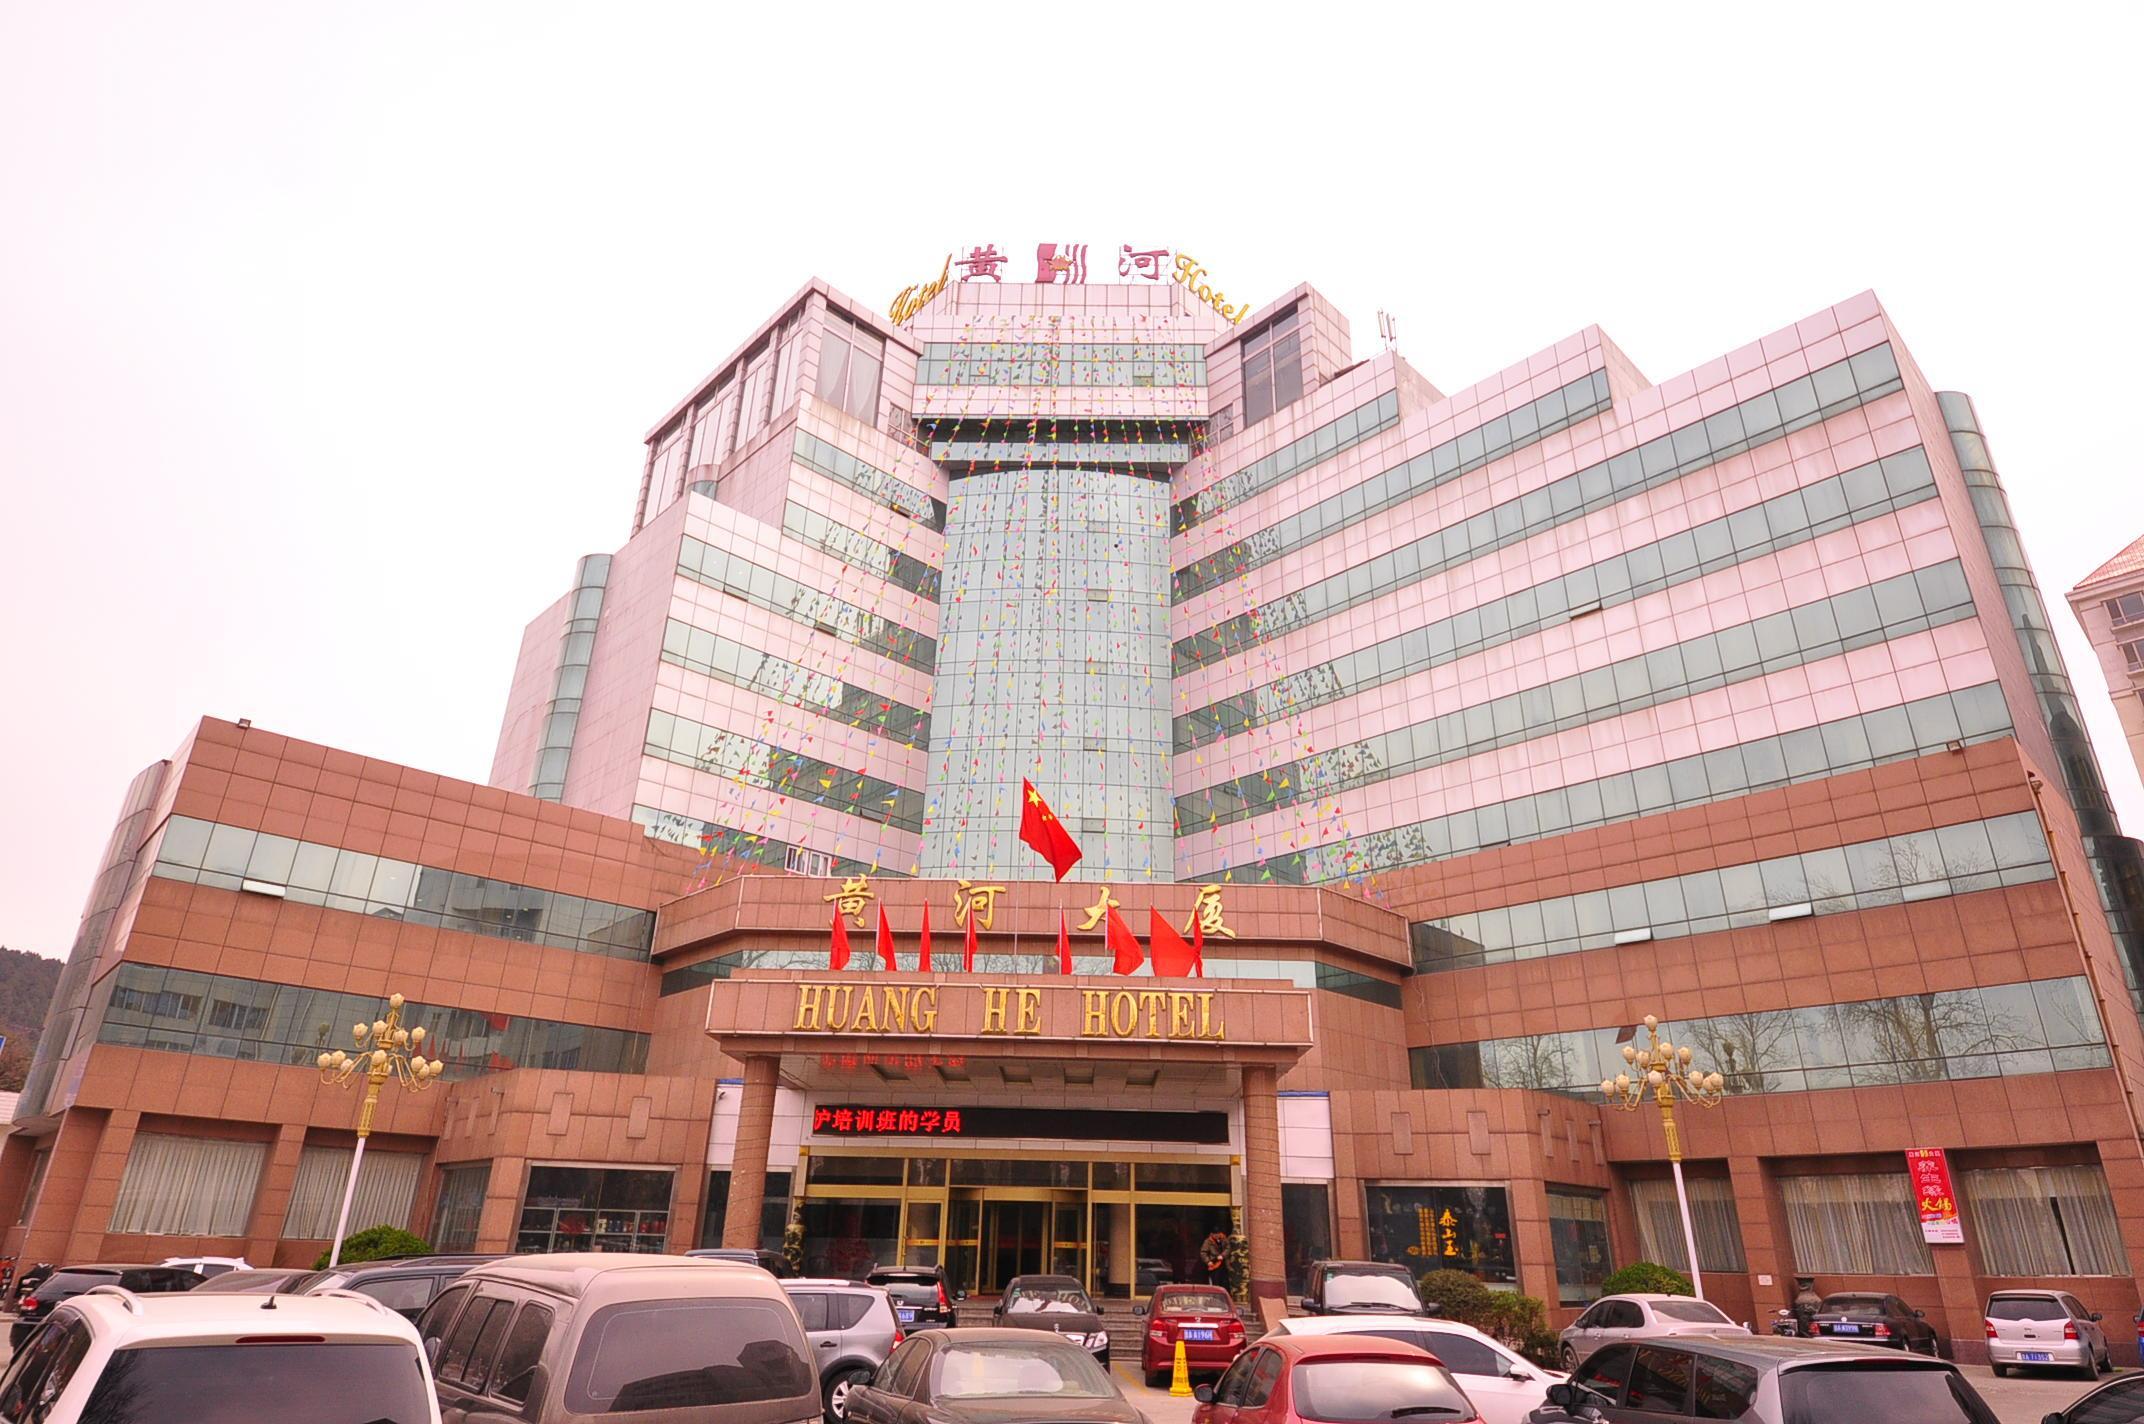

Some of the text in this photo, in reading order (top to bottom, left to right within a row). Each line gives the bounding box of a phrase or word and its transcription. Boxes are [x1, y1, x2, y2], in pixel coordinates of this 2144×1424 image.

[1172, 254, 1250, 325] Hotel
[793, 984, 1226, 1040] HUANG HE HOTEL
